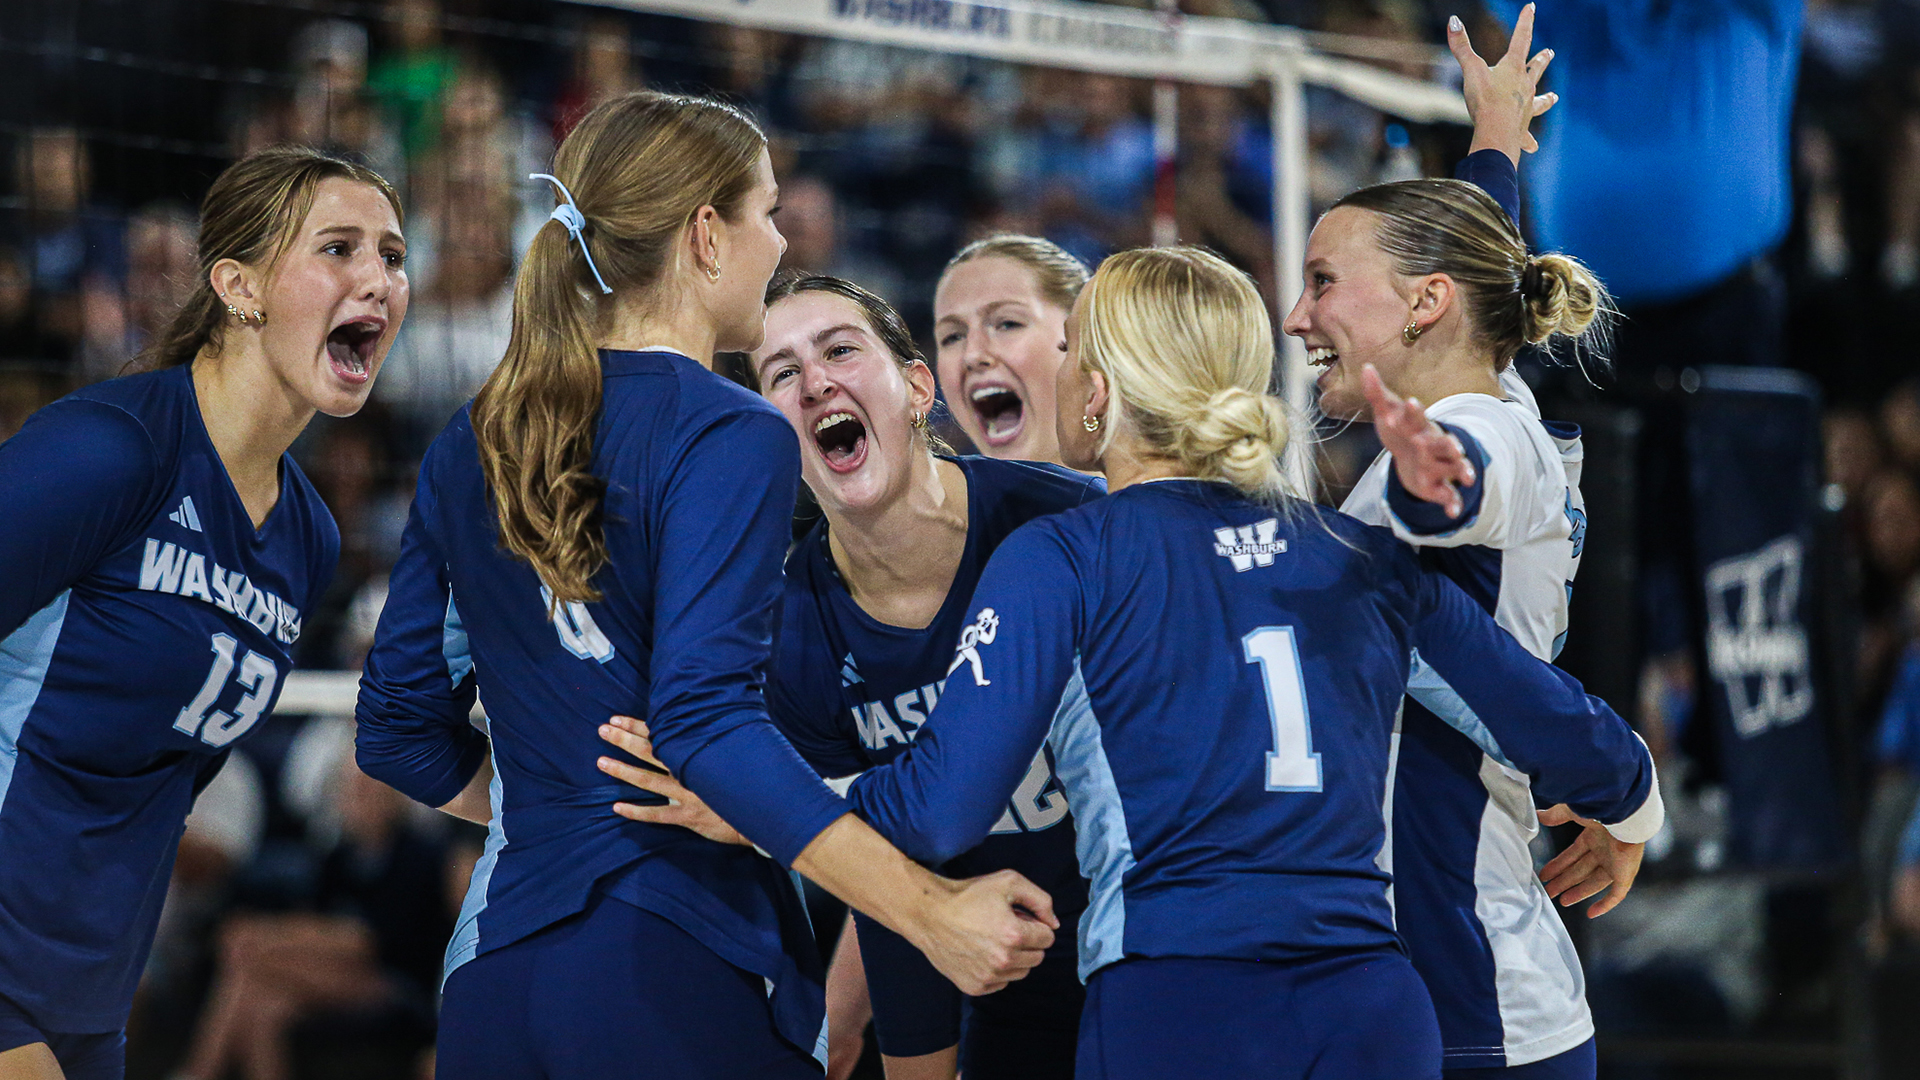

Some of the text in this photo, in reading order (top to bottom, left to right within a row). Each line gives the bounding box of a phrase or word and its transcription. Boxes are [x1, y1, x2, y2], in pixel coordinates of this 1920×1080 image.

[1213, 539, 1288, 557] WASHBURN
[172, 632, 278, 748] 13
[1241, 625, 1324, 793] 1
